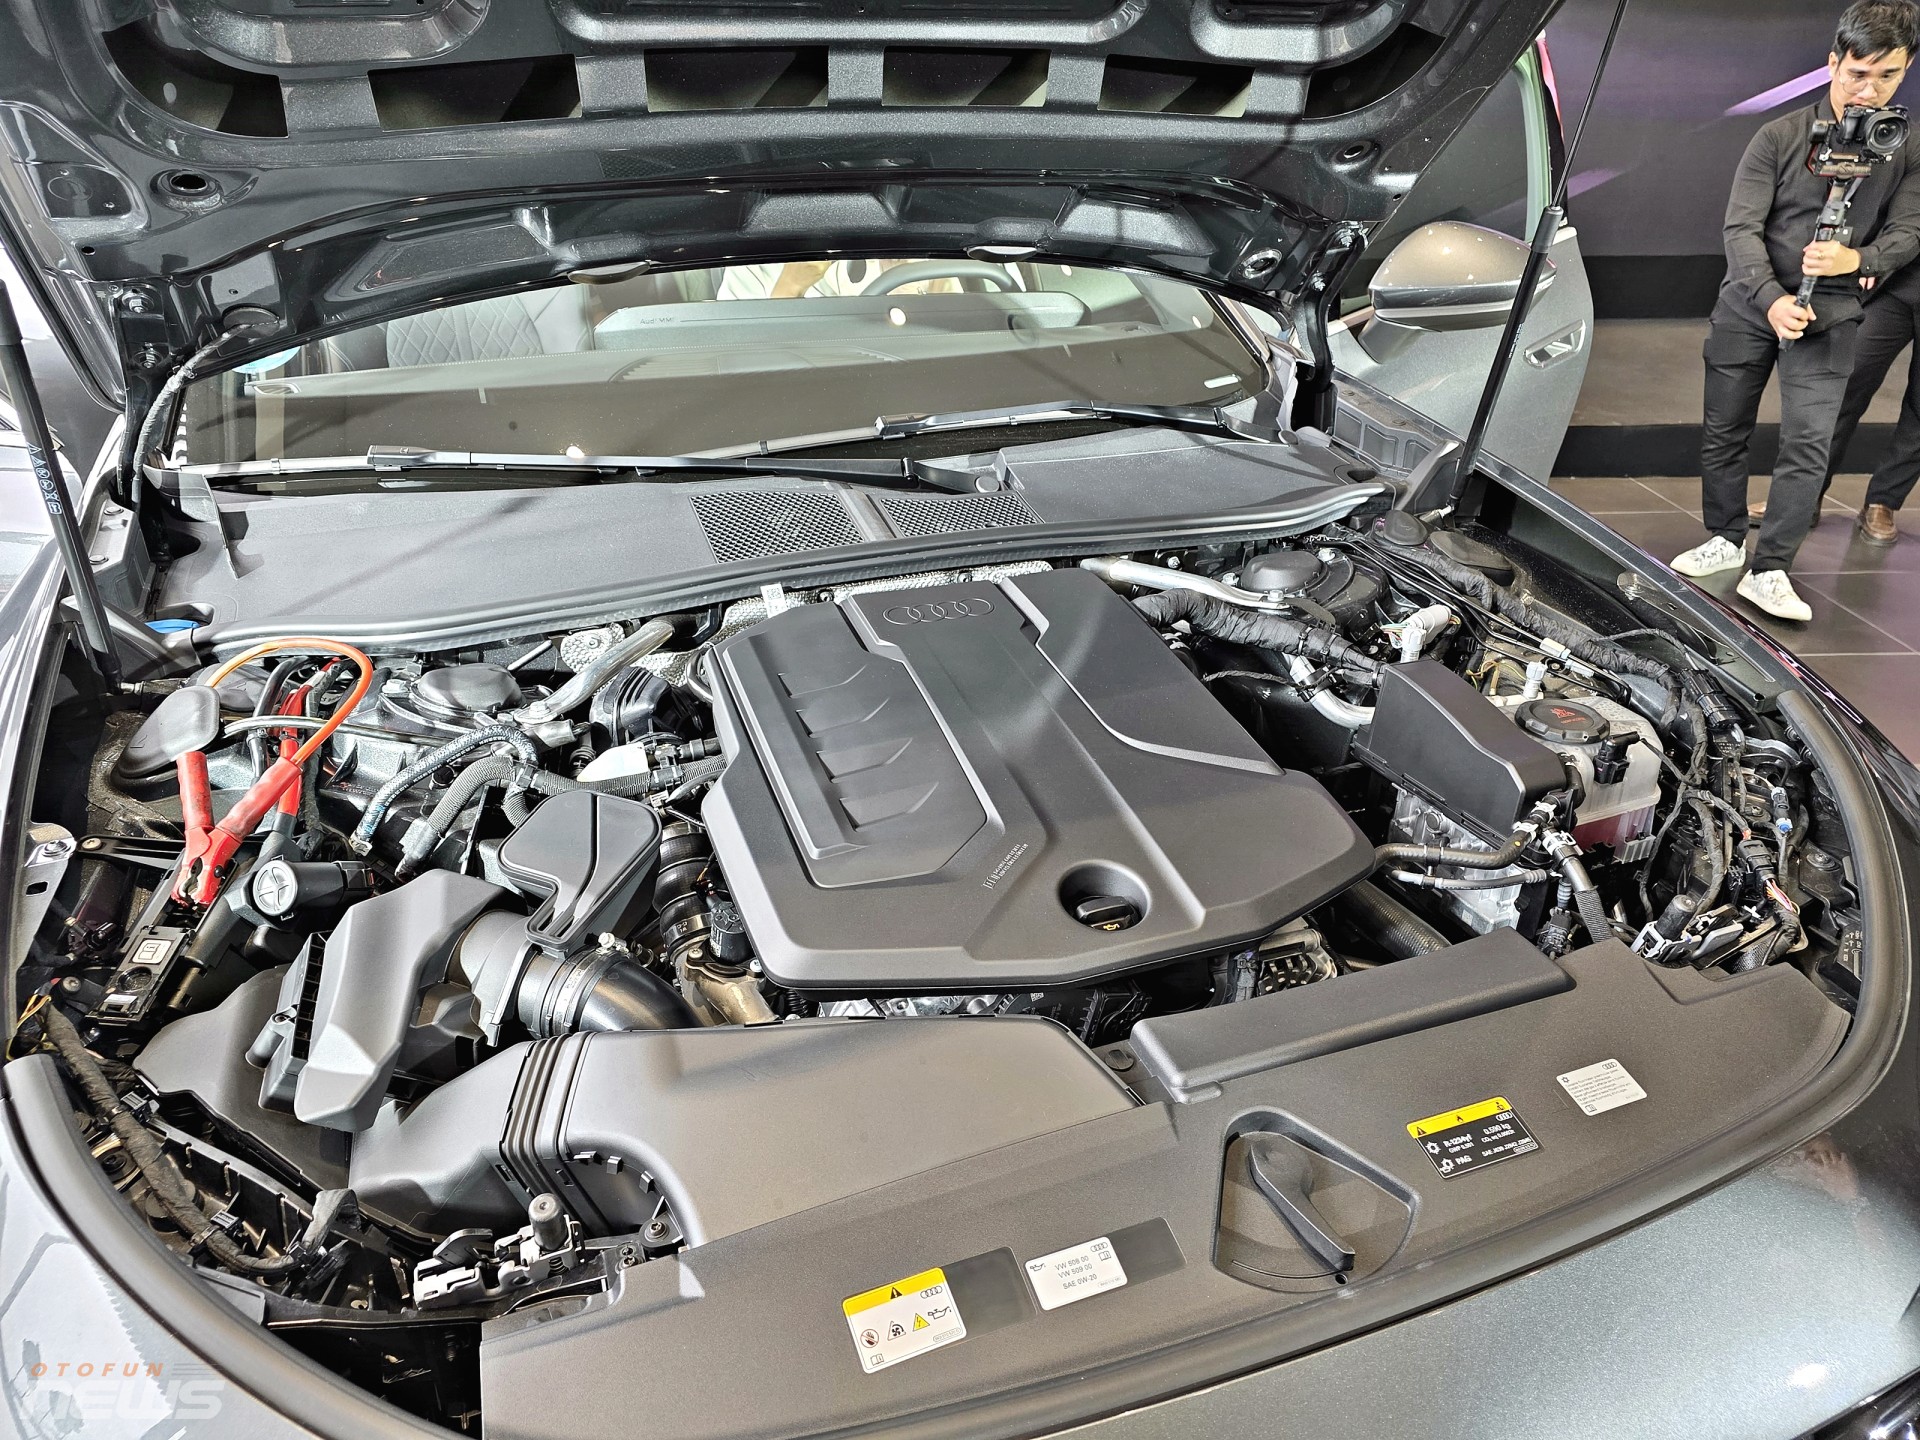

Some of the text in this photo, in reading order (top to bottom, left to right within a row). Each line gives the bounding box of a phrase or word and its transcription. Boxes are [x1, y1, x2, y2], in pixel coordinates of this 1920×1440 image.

[1455, 1155, 1473, 1165] PAG
[1054, 1255, 1089, 1271] VW 508 00
[1058, 1270, 1070, 1279] VW
[1071, 1266, 1084, 1275] 509
[1062, 1280, 1077, 1290] SAE
[1077, 1273, 1098, 1285] 0W-20
